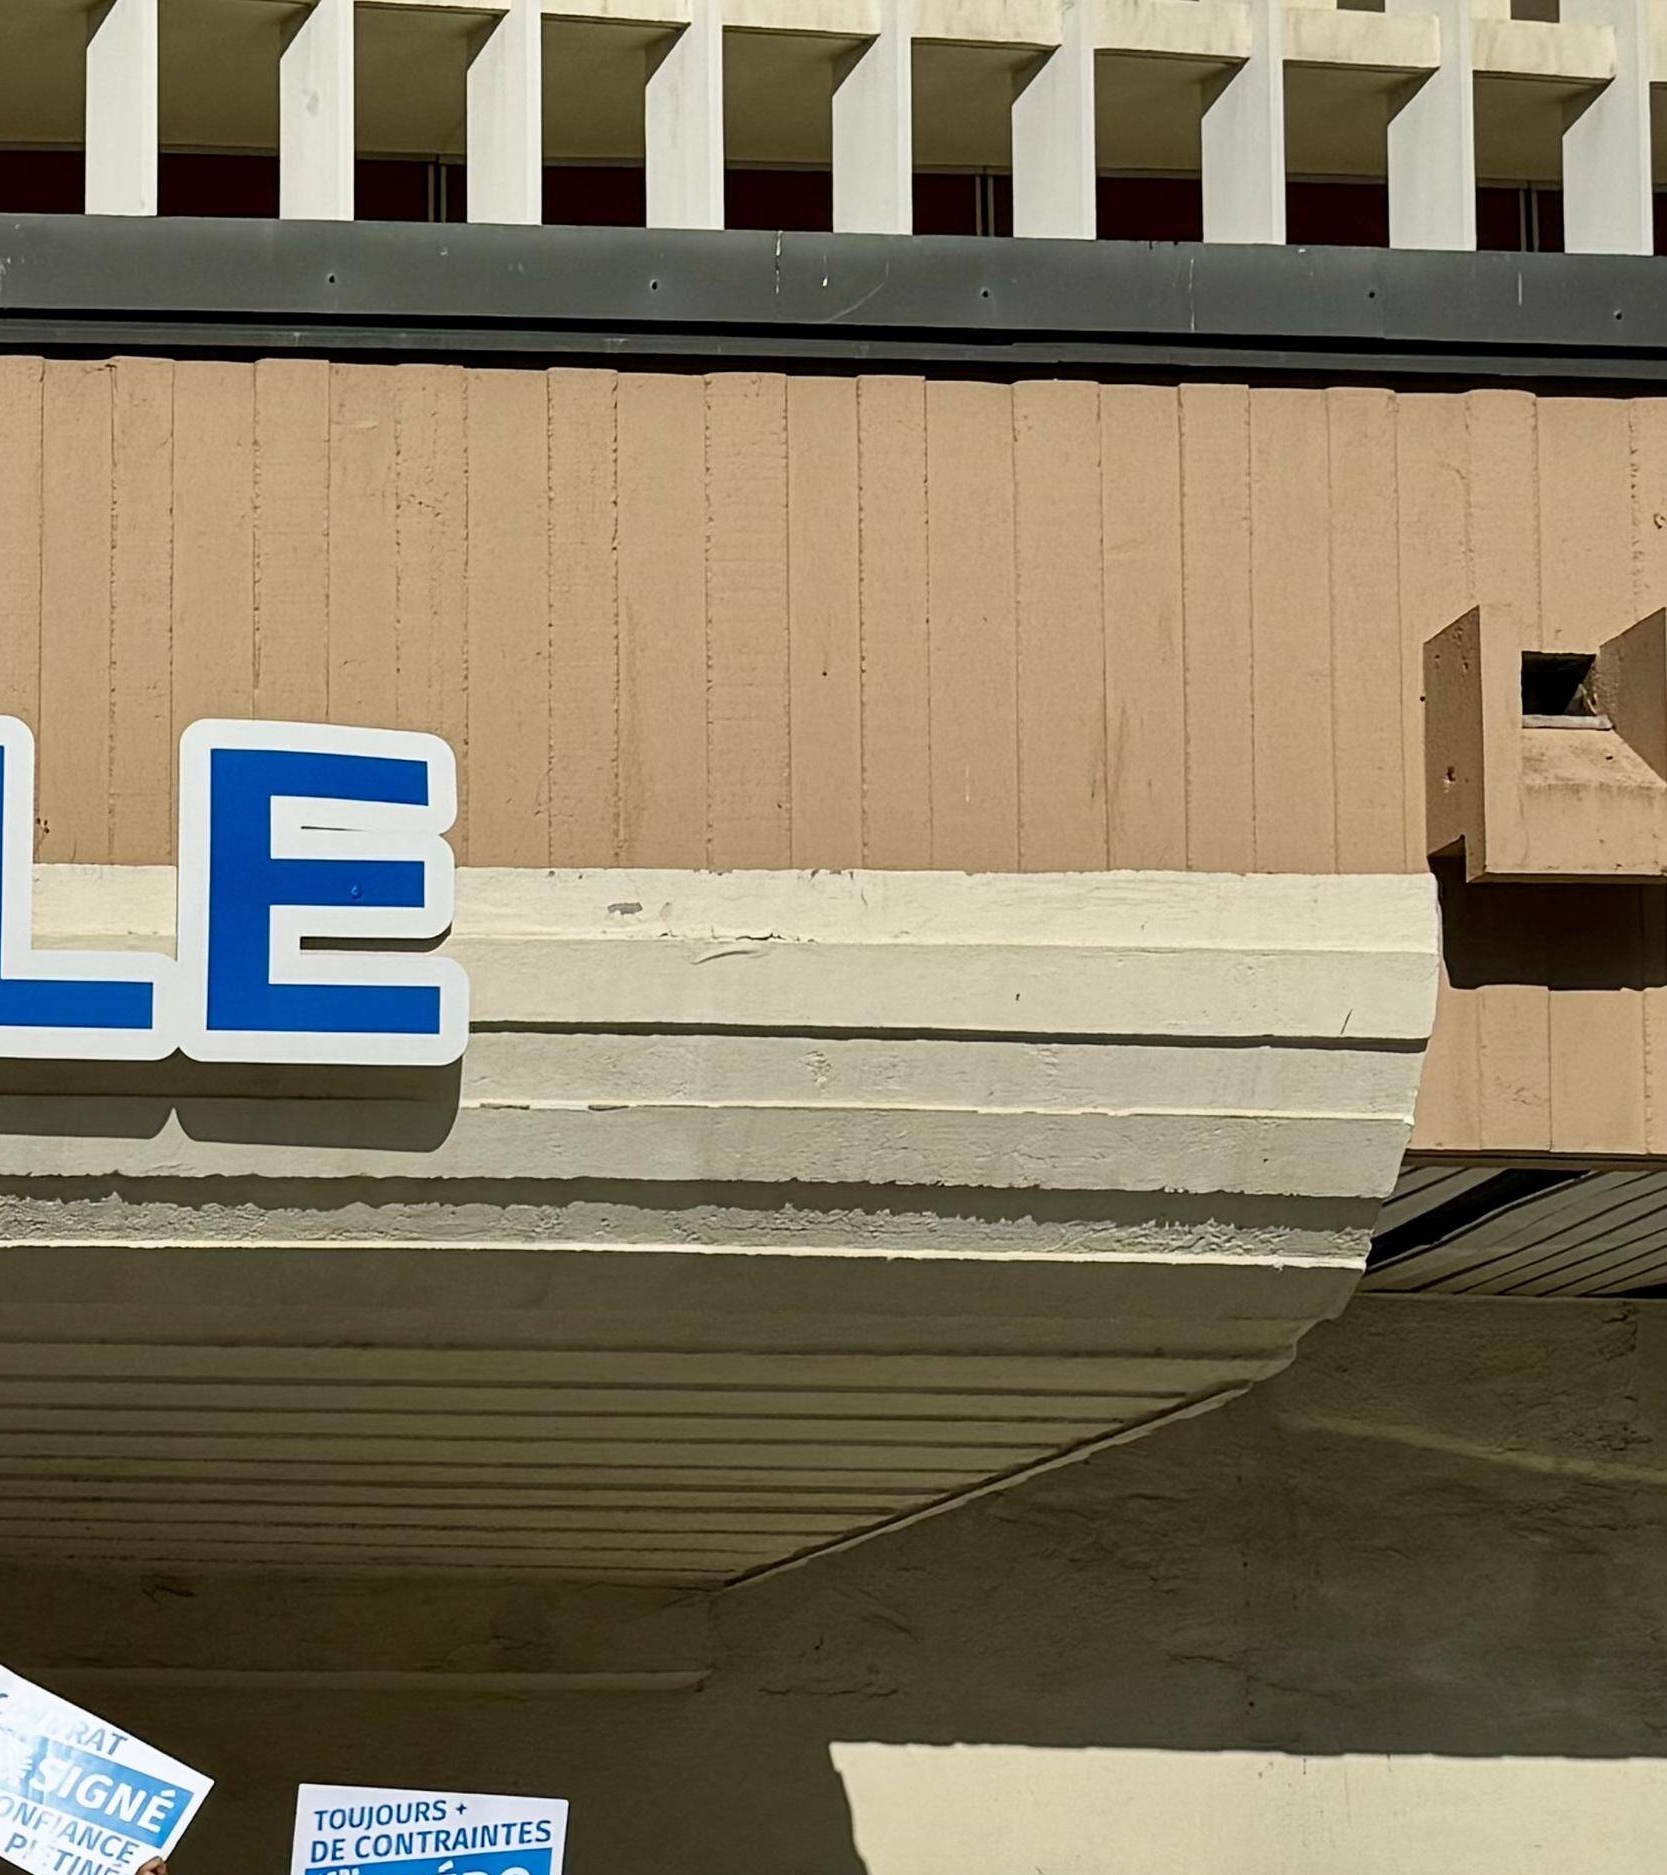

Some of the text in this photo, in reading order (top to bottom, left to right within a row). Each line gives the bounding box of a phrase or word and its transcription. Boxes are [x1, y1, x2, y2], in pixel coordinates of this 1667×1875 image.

[29, 1756, 176, 1835] SIGNÉ
[313, 1799, 468, 1832] TOUJOURS +
[310, 1819, 552, 1864] DE CONTRAINTES
